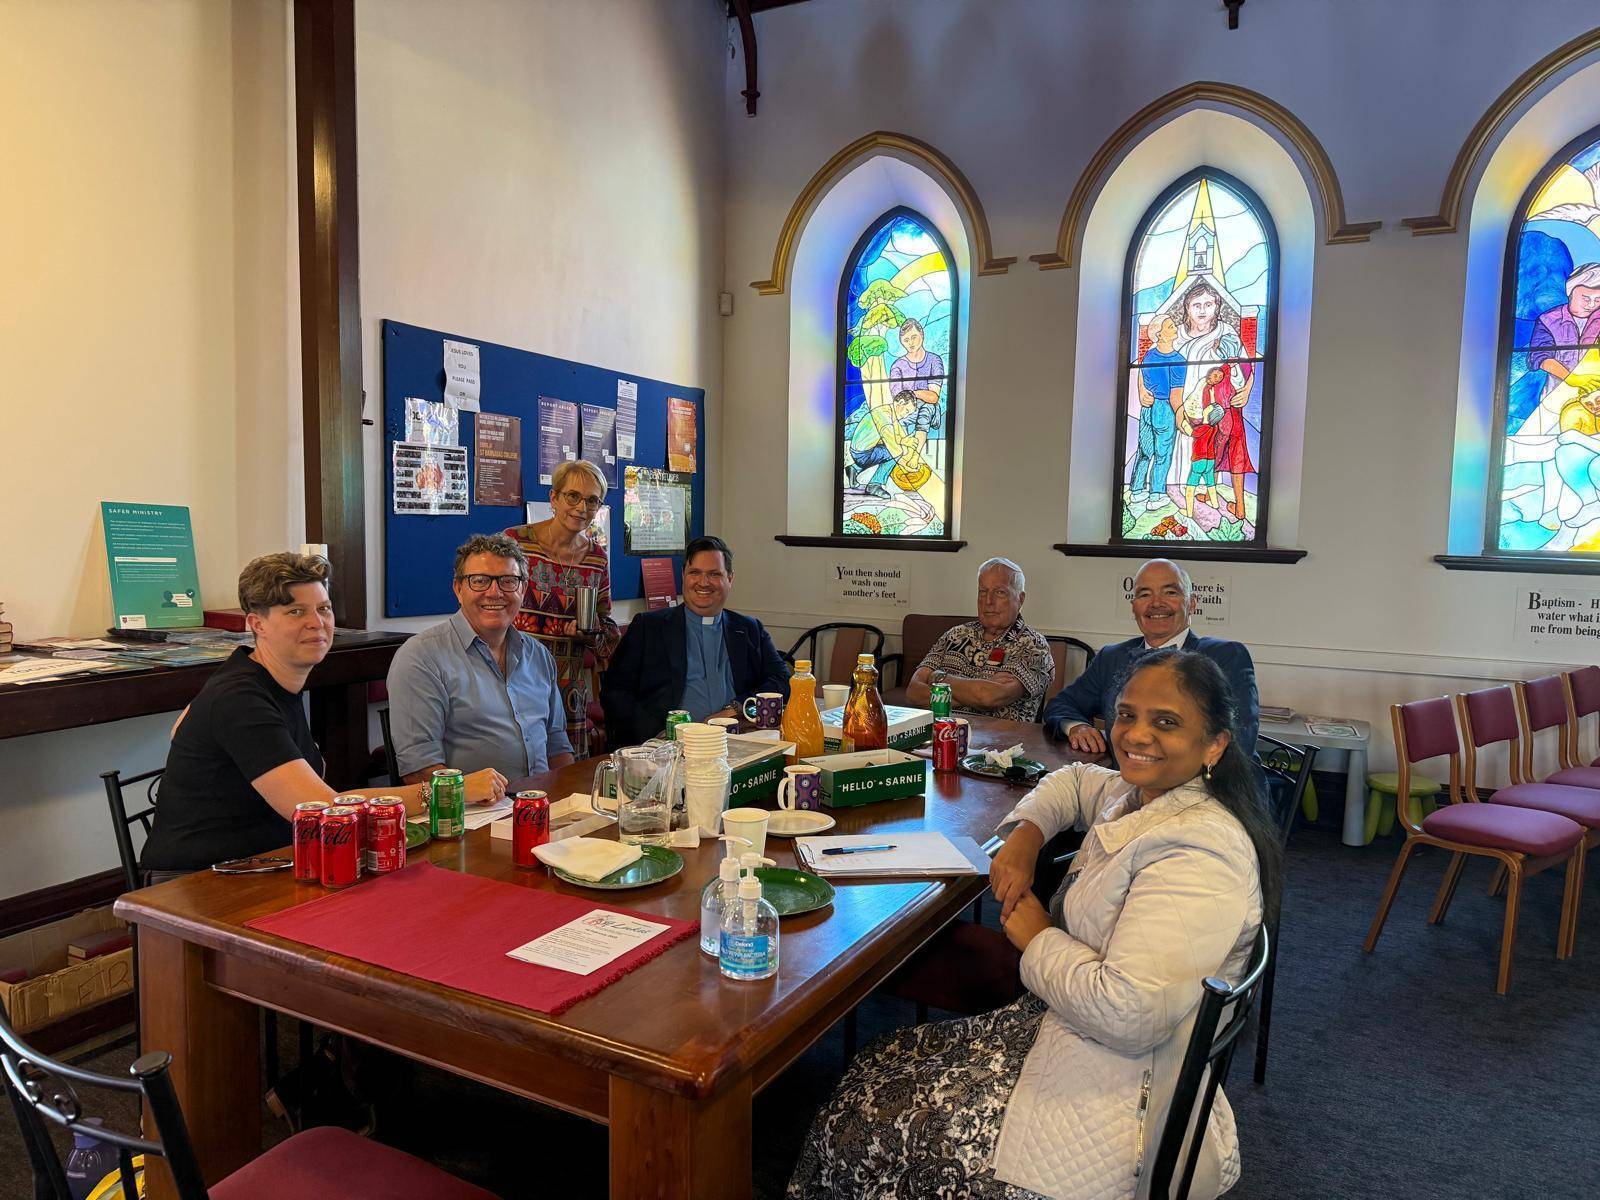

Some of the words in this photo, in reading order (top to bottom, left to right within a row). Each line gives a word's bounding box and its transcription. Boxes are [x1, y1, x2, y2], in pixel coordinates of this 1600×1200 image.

[836, 566, 853, 580] You
[855, 569, 873, 577] then
[875, 570, 901, 579] should
[851, 579, 871, 587] wash
[1216, 583, 1225, 593] is
[842, 589, 880, 598] another's
[881, 591, 896, 599] feet
[1528, 592, 1575, 610] Baptism
[1537, 612, 1566, 621] water
[1569, 612, 1594, 623] what
[1530, 625, 1546, 633] me
[1547, 624, 1573, 635] from
[904, 726, 926, 739] SARNIE
[748, 769, 777, 788] SARNIE
[842, 780, 874, 793] HELLO
[885, 773, 923, 787] SARNIE
